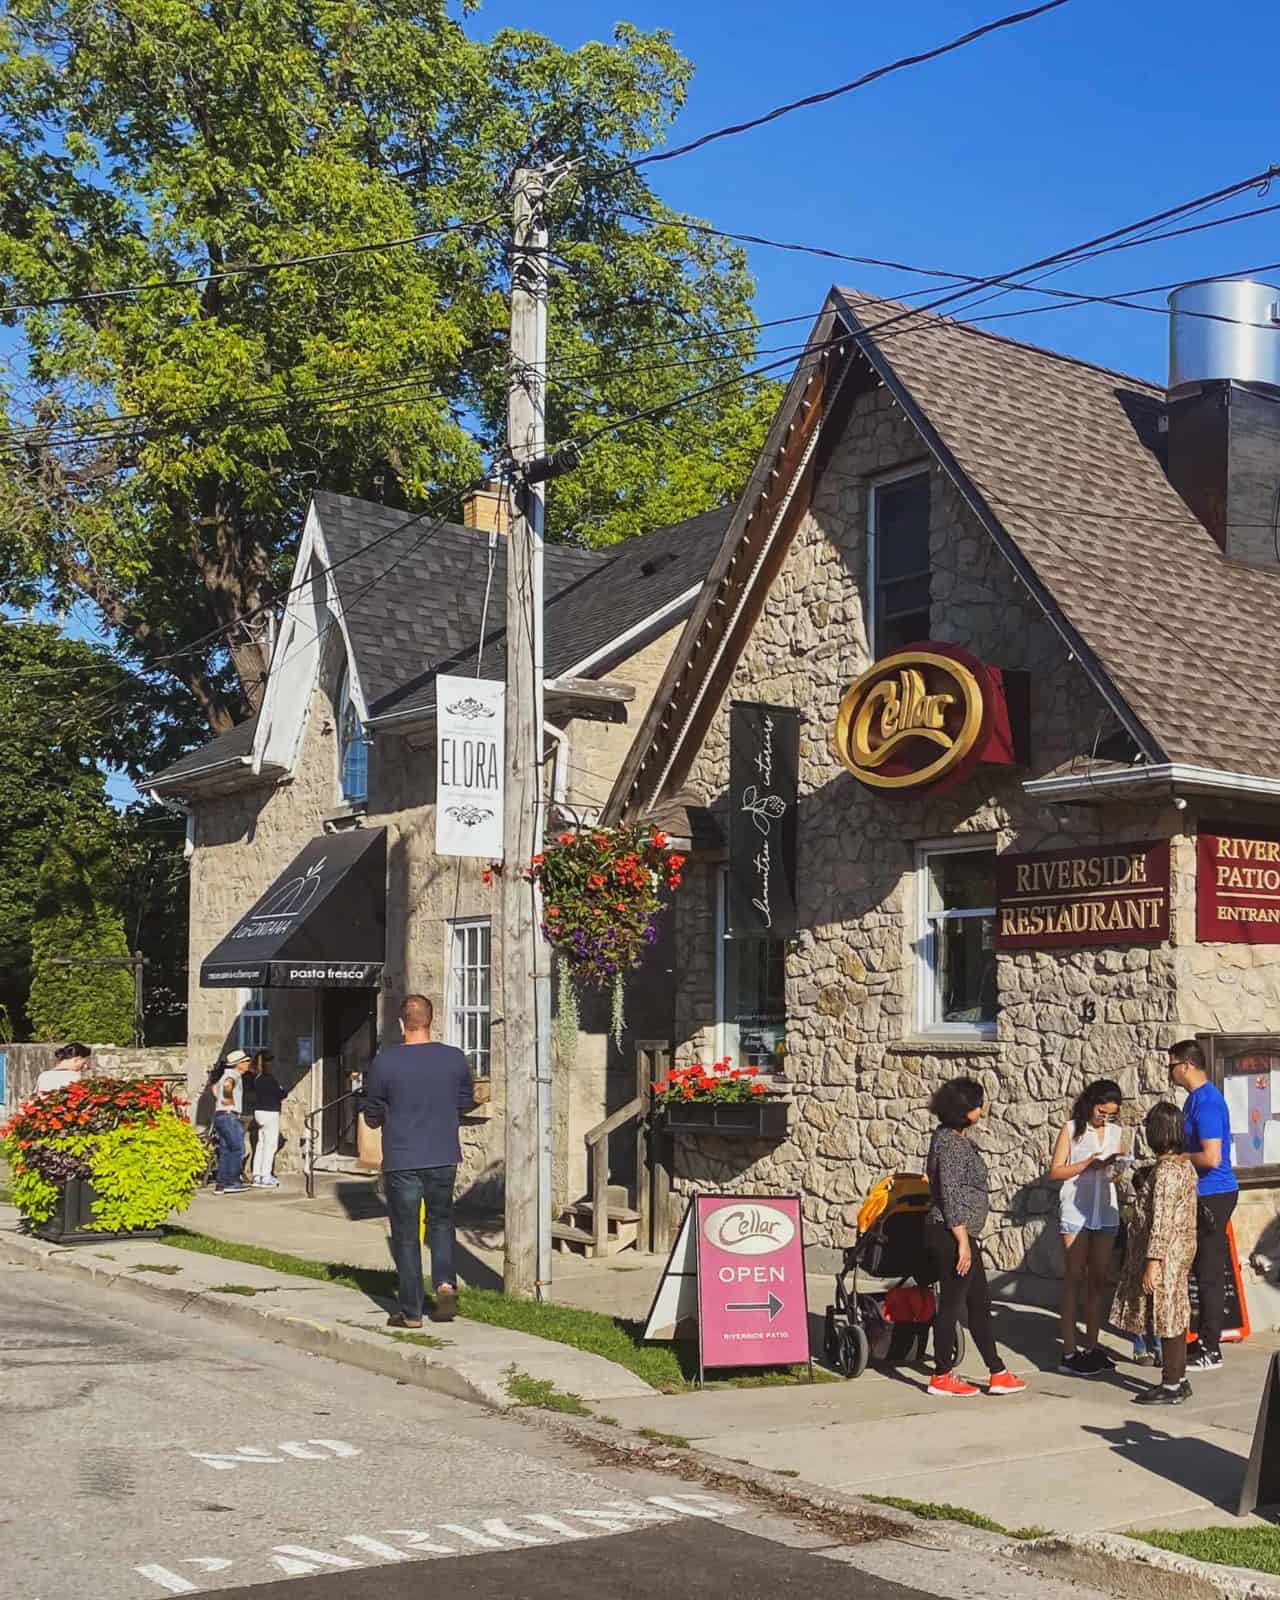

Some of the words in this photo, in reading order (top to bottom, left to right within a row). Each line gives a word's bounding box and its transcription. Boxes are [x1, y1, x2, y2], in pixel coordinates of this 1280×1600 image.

[852, 668, 954, 768] Cellar
[441, 738, 499, 790] ELORA
[1015, 854, 1147, 893] RIVERSIDE
[1215, 866, 1280, 891] PATIO
[1000, 898, 1164, 937] RESTAURANT
[290, 968, 326, 980] pasta
[327, 967, 364, 979] fresca
[719, 1207, 782, 1246] Cellar
[719, 1266, 785, 1283] OPEN
[766, 1331, 789, 1339] PATIO
[188, 1439, 362, 1471] NO
[132, 1494, 748, 1594] PARKING
